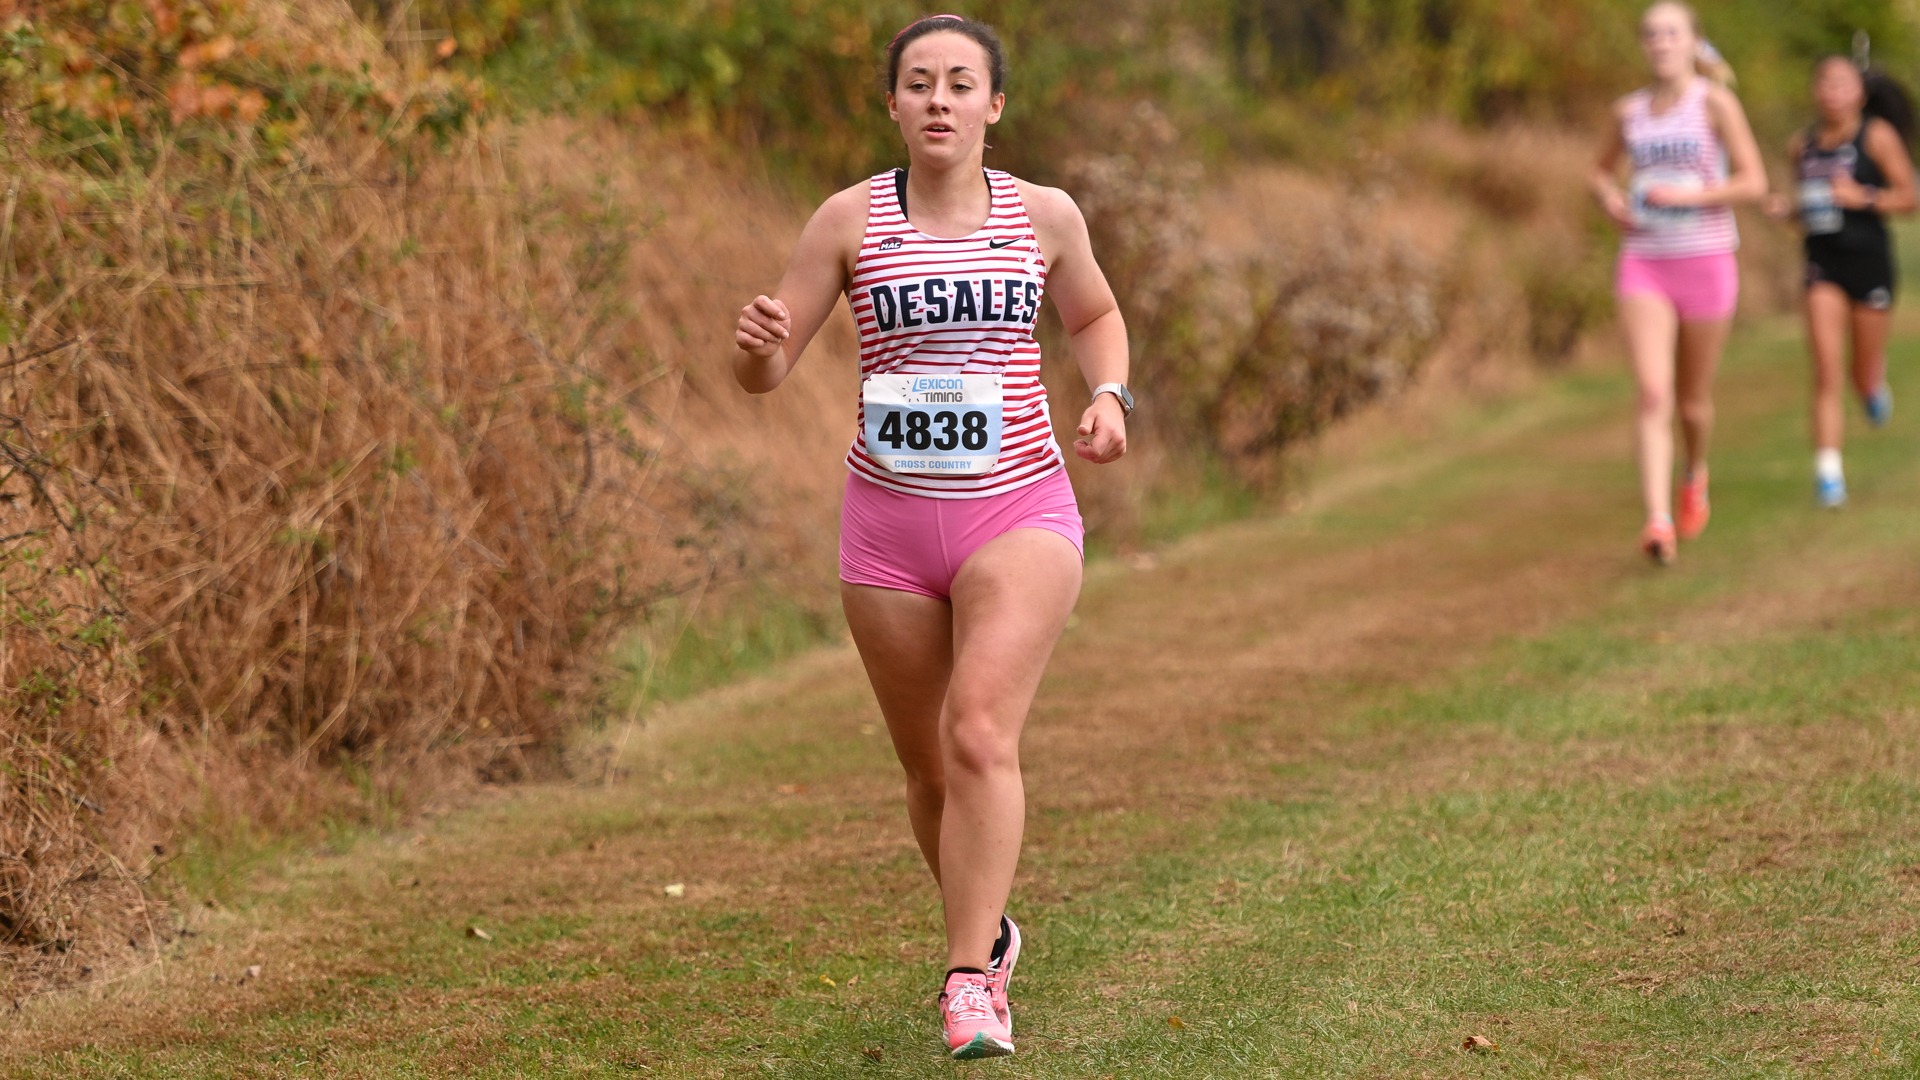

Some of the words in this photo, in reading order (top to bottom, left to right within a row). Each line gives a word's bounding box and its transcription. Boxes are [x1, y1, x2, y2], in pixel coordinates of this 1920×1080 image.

[880, 242, 901, 250] MAC
[870, 278, 1038, 332] DESALES
[912, 377, 963, 393] LEXICON
[919, 391, 963, 403] TIMING
[877, 410, 988, 451] 4838
[894, 460, 926, 469] CROSS
[928, 460, 972, 470] COUNTRY
